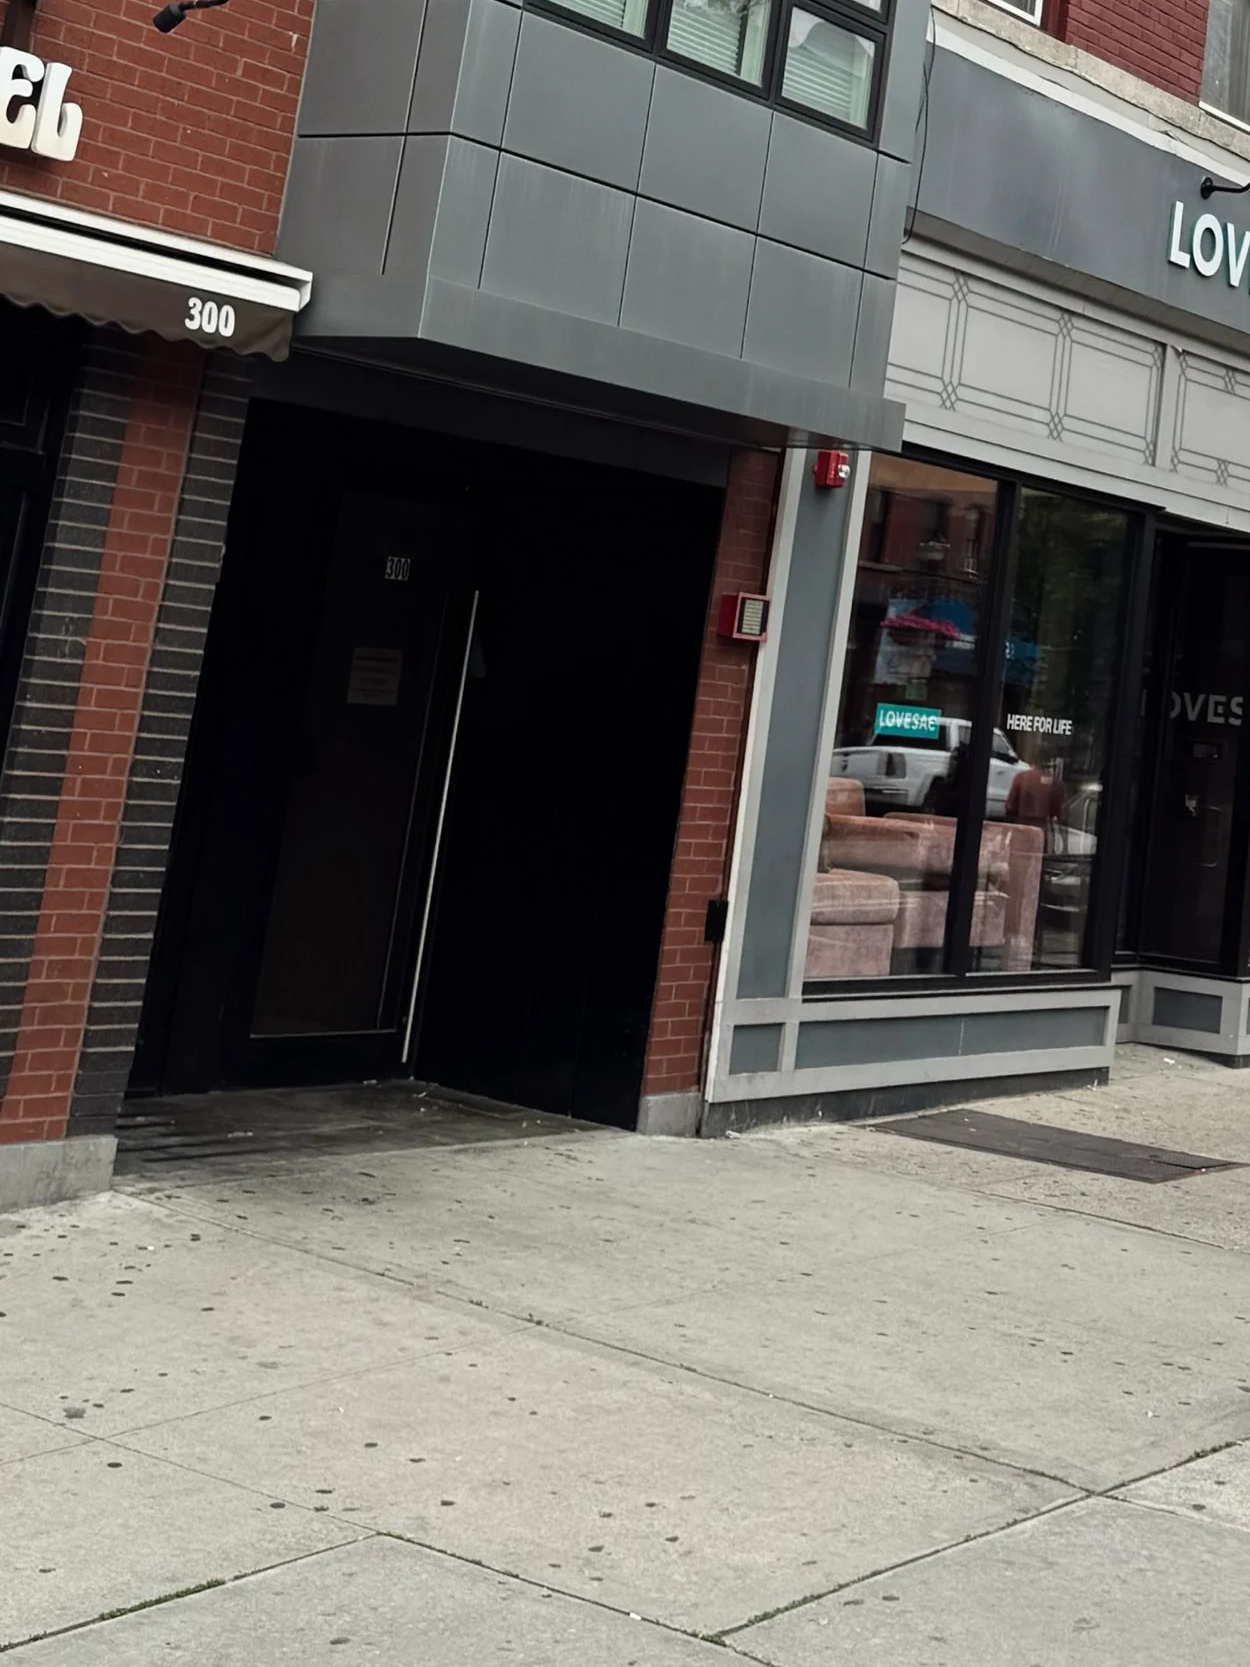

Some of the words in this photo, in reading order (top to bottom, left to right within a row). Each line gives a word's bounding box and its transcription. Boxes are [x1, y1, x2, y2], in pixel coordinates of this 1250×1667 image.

[184, 297, 236, 338] 300
[386, 557, 410, 579] 300
[879, 709, 937, 732] LOVESAC
[1007, 714, 1032, 731] HERE
[1033, 716, 1051, 733] FOR
[1053, 719, 1073, 735] LIFE
